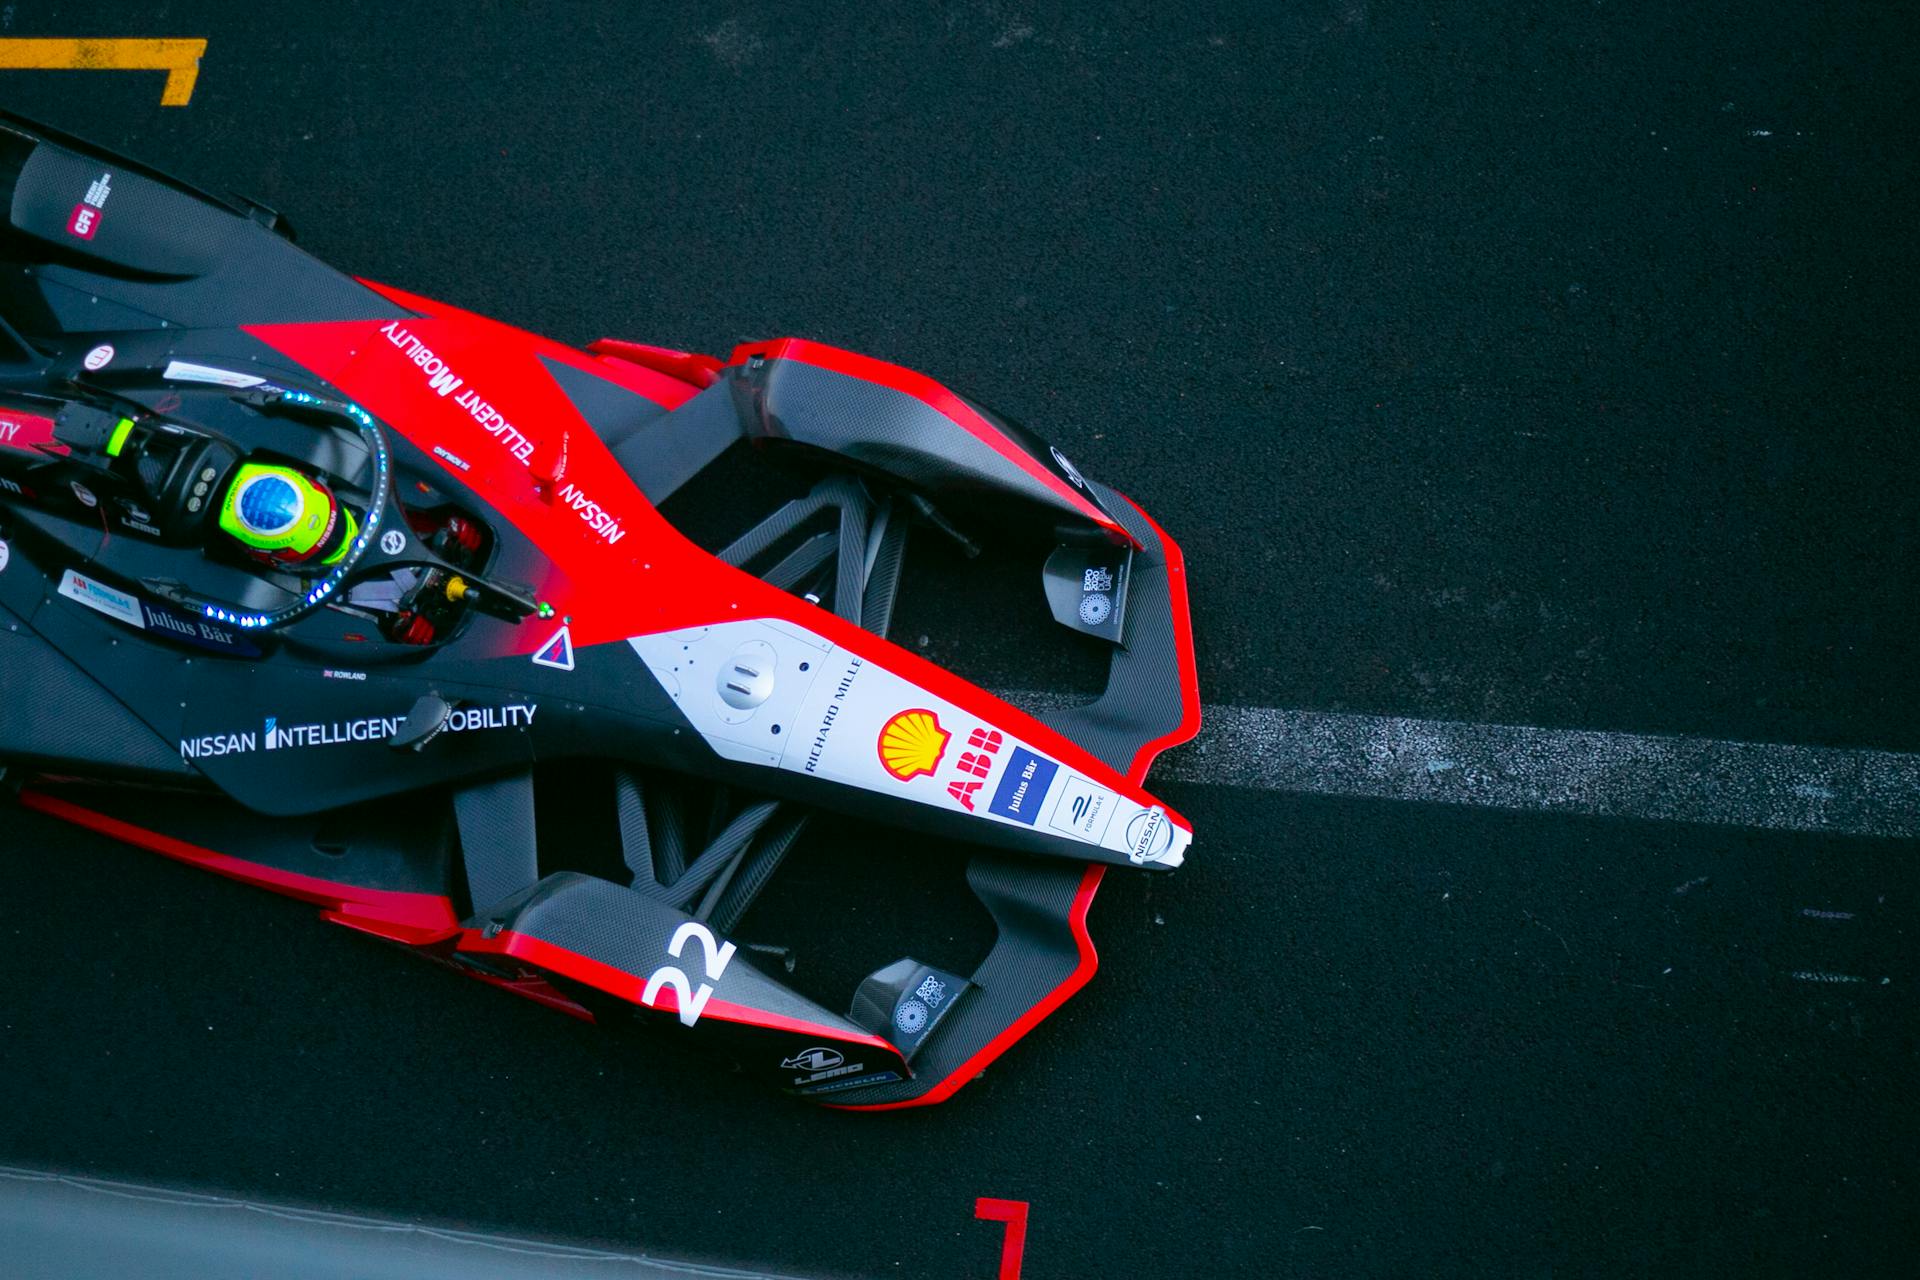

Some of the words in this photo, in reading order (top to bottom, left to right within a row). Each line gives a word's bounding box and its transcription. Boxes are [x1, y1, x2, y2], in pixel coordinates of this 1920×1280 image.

[75, 209, 95, 234] CFI
[380, 321, 464, 397] MOBILITY
[455, 389, 535, 467] ELLIGENT
[316, 510, 337, 548] NISSAN
[558, 483, 626, 545] NISSAN
[1083, 568, 1094, 591] EXPO
[1091, 570, 1100, 591] 2020
[145, 606, 197, 637] Julius
[200, 623, 233, 644] Bär
[334, 670, 367, 681] ROWLAND
[181, 732, 257, 758] NISSAN
[265, 717, 408, 750] INTELLIGEN
[442, 704, 538, 733] OBILITY
[805, 704, 839, 773] RICHARD
[834, 657, 864, 701] MILLE
[947, 727, 1003, 813] ABB
[1008, 779, 1028, 813] Julius
[1021, 759, 1038, 779] Bär
[1135, 810, 1160, 858] NISSAN
[642, 921, 737, 1028] 22
[915, 975, 935, 997] EXPO
[921, 981, 939, 1001] 2020
[794, 1063, 864, 1085] LEMO
